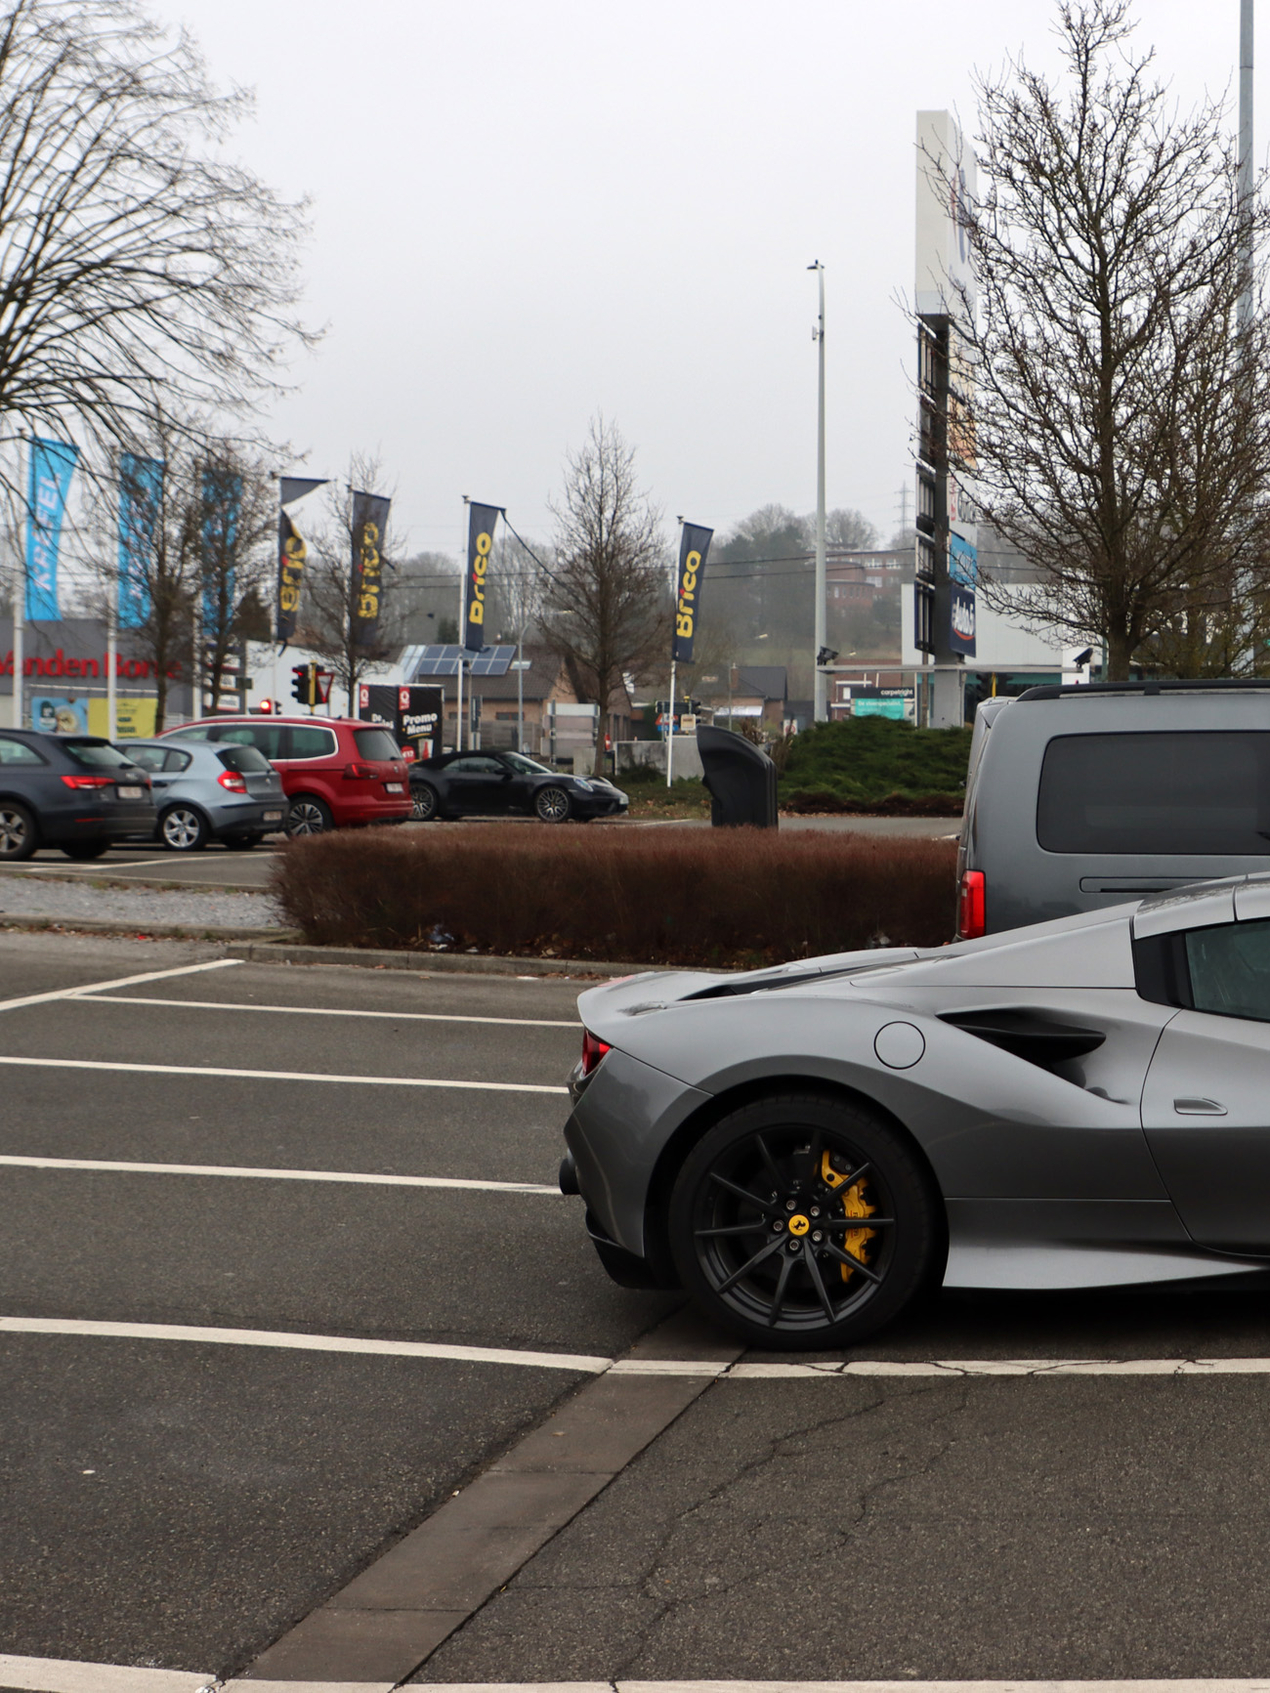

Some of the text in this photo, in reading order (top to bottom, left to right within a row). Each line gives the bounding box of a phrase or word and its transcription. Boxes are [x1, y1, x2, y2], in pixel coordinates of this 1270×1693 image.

[676, 550, 702, 638] Brico
[403, 712, 438, 726] Promo
[406, 724, 433, 735] Menu
